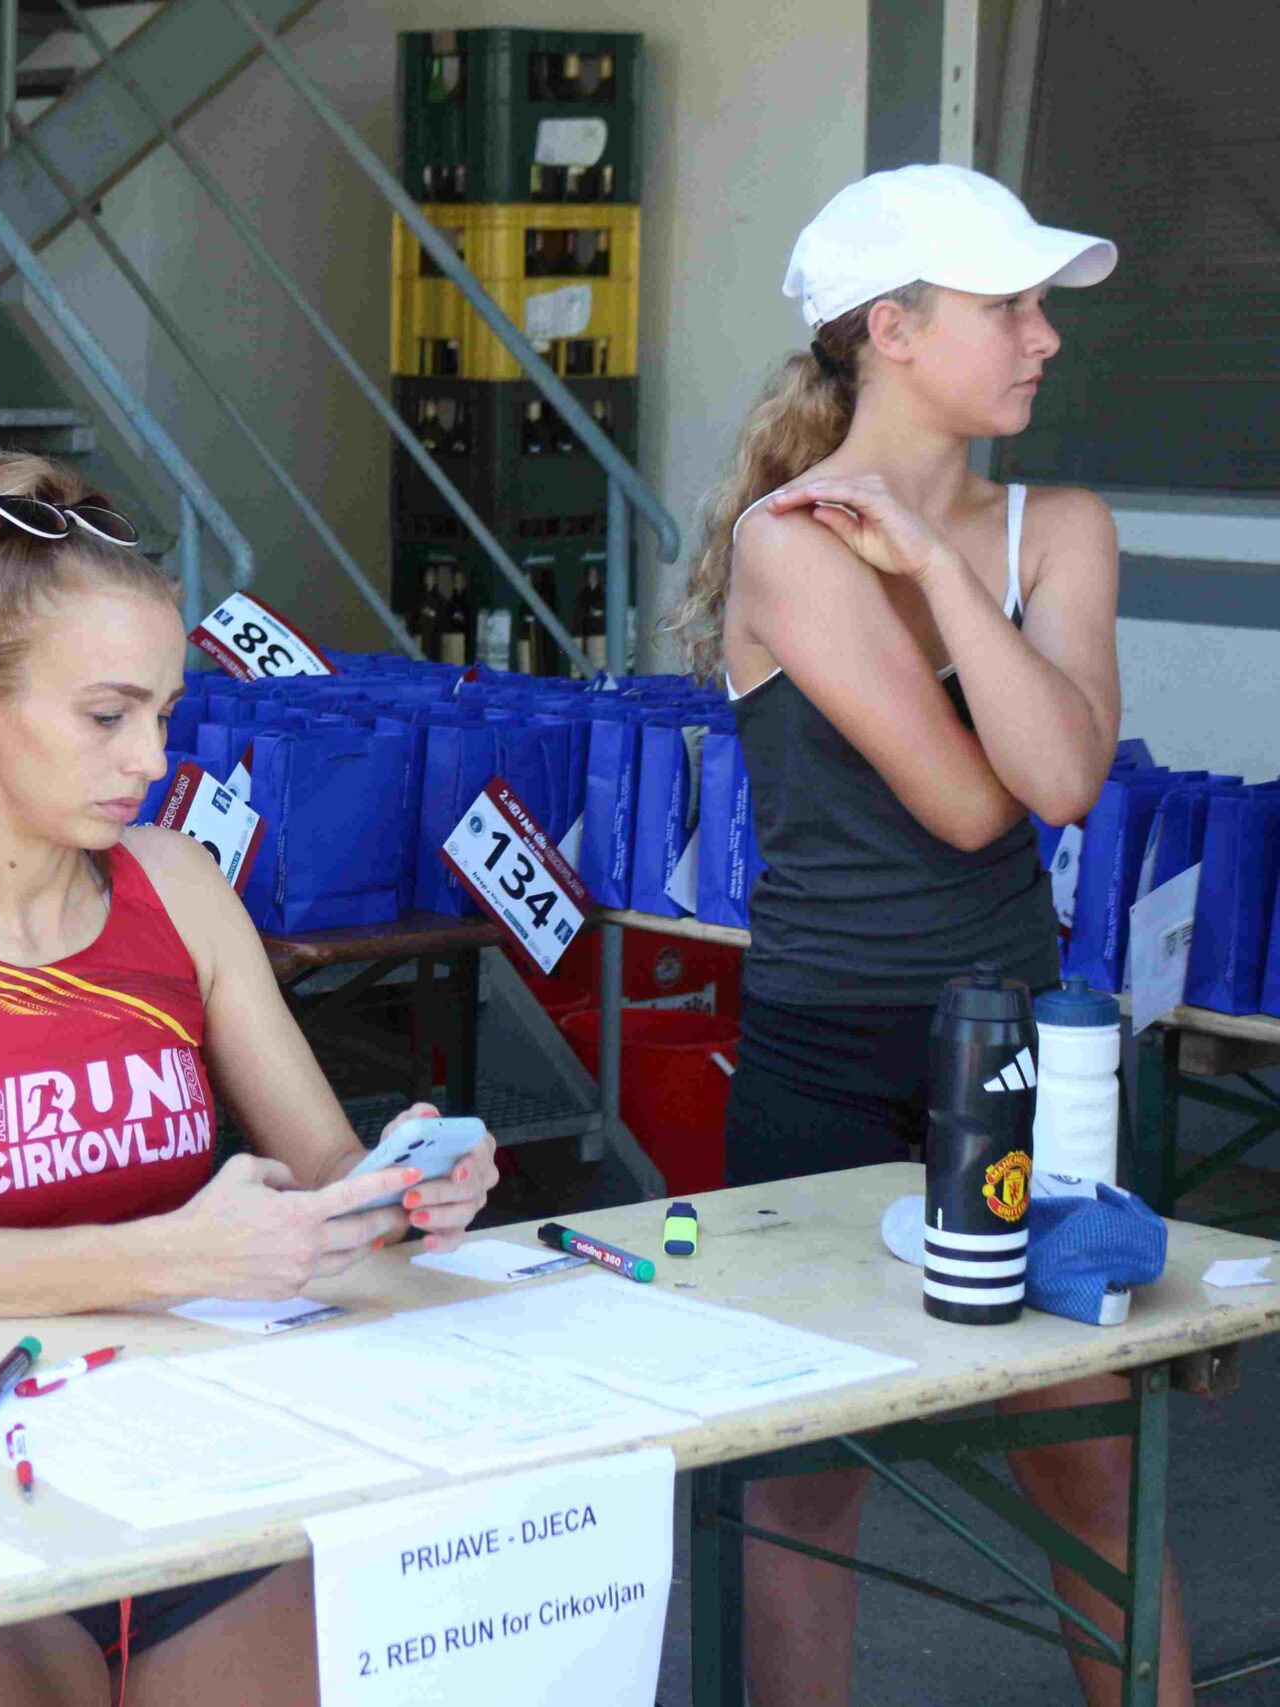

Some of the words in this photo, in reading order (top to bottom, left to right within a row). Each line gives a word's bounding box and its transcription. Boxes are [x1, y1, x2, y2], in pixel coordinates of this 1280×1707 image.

[160, 774, 190, 829] RKOVLJAN
[484, 831, 558, 929] 134
[20, 1048, 182, 1136] RUN
[182, 1049, 204, 1104] FOR
[576, 1241, 602, 1261] edding
[603, 1251, 622, 1266] 360
[401, 1528, 499, 1575] PRIJAVE
[521, 1505, 597, 1544] DJECA
[359, 1651, 378, 1676] 2.
[387, 1634, 436, 1669] RED
[444, 1620, 494, 1653] RUN
[502, 1612, 532, 1638] for
[539, 1581, 645, 1626] Cirkovljan
